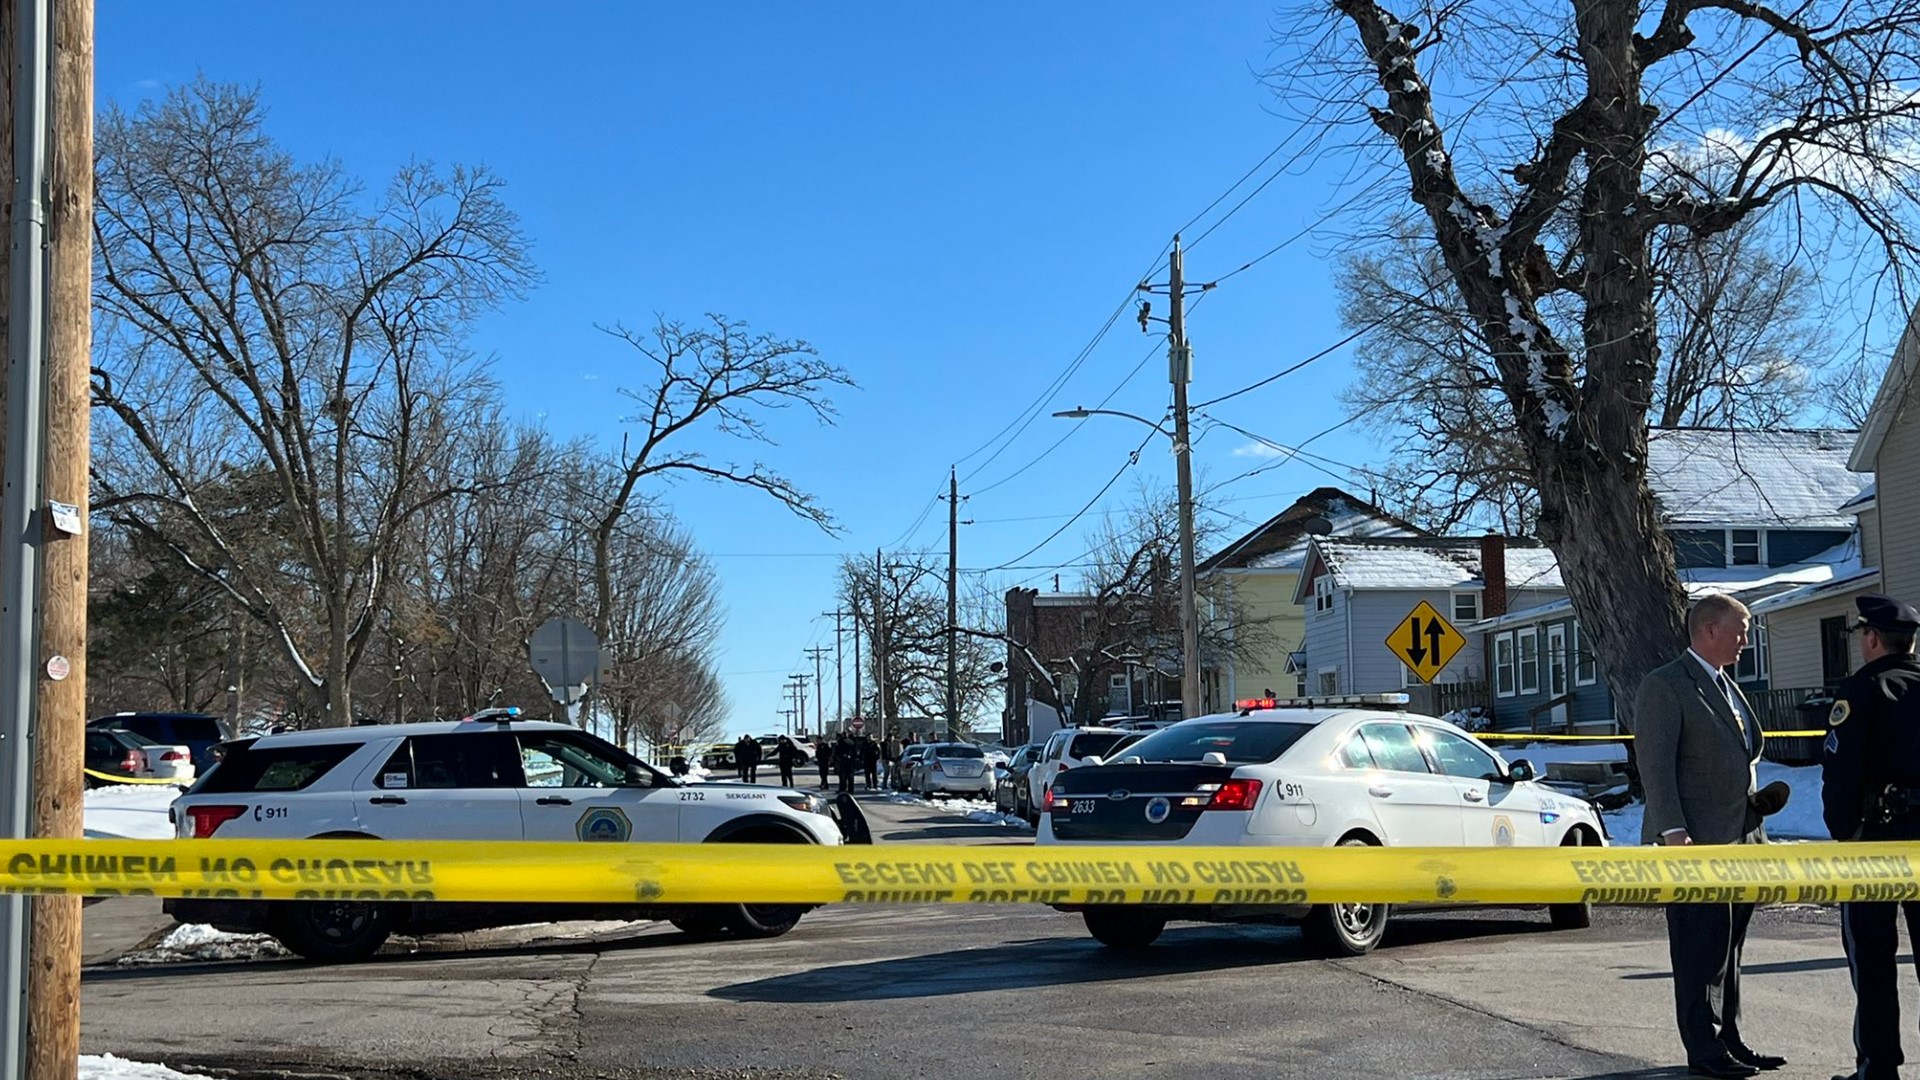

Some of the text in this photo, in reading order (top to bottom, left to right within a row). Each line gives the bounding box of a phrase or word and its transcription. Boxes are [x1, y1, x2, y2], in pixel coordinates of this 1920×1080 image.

[1285, 783, 1304, 796] 911
[680, 792, 705, 801] 2732
[1072, 800, 1096, 813] 2633
[266, 807, 288, 819] 911
